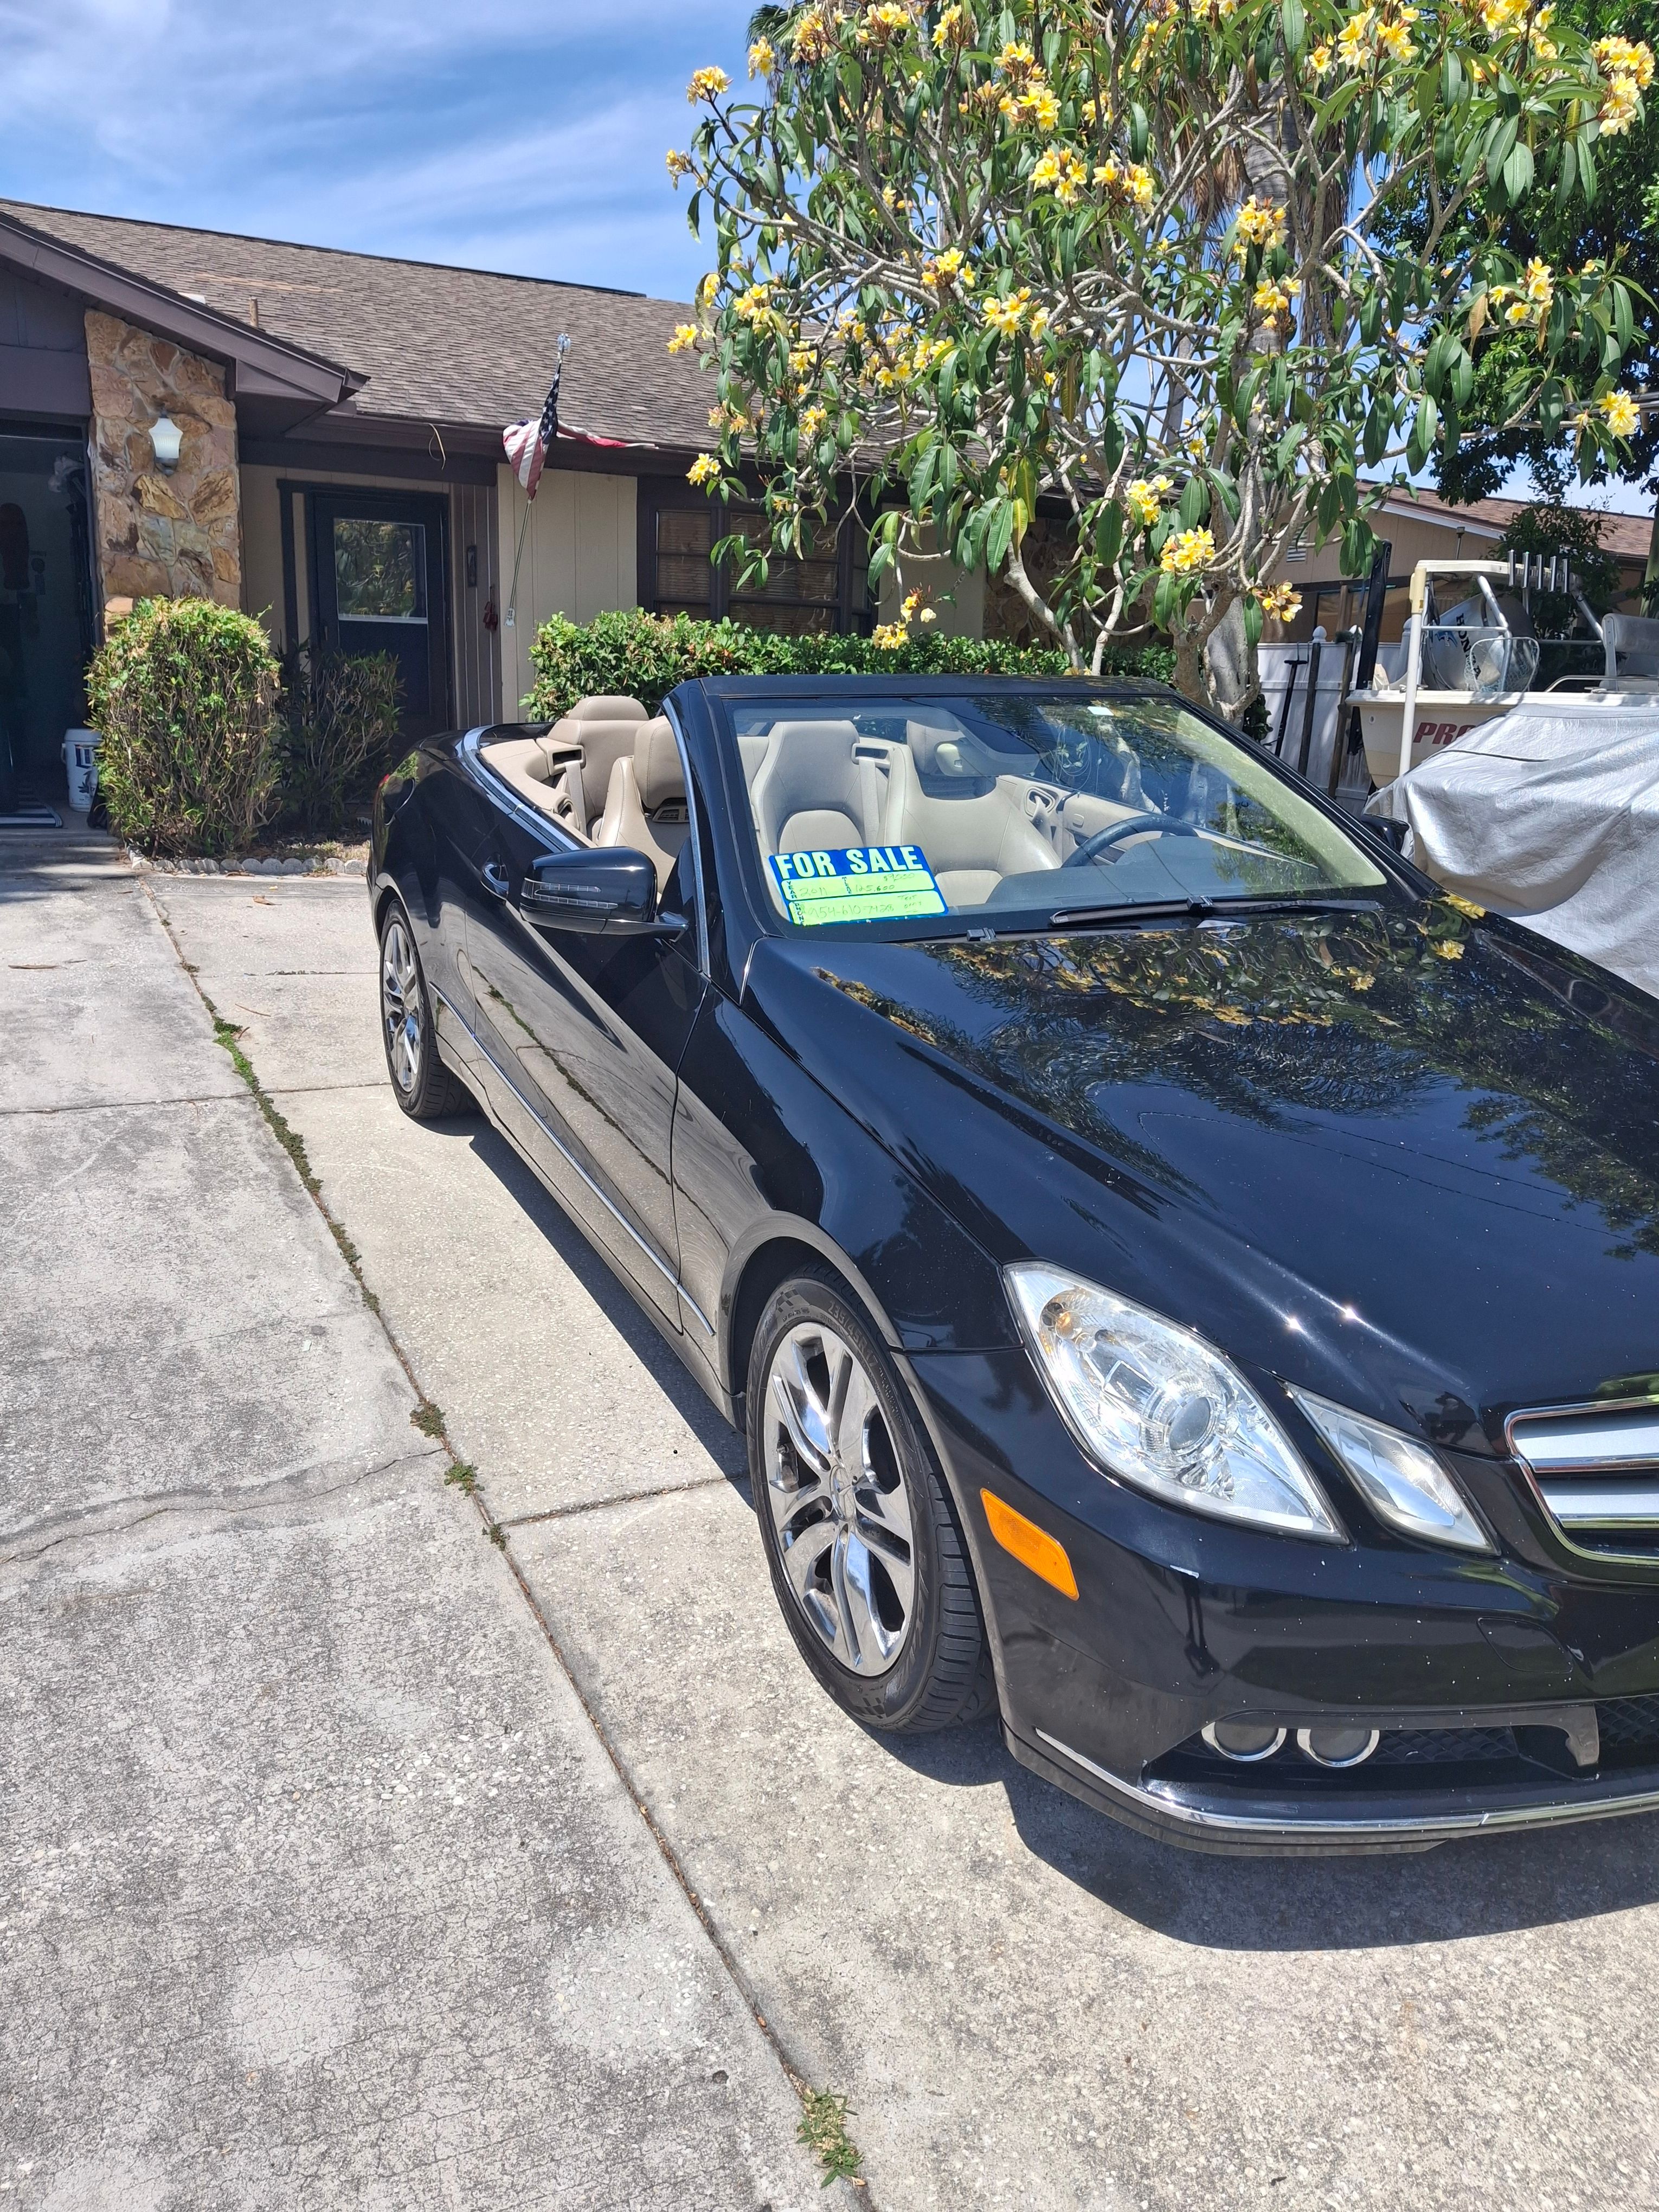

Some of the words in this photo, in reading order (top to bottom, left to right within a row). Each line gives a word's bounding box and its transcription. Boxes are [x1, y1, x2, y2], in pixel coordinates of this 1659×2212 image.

[775, 852, 836, 879] FOR
[846, 846, 923, 874] SALE
[787, 881, 797, 898] YEAR
[799, 888, 827, 896] 2011
